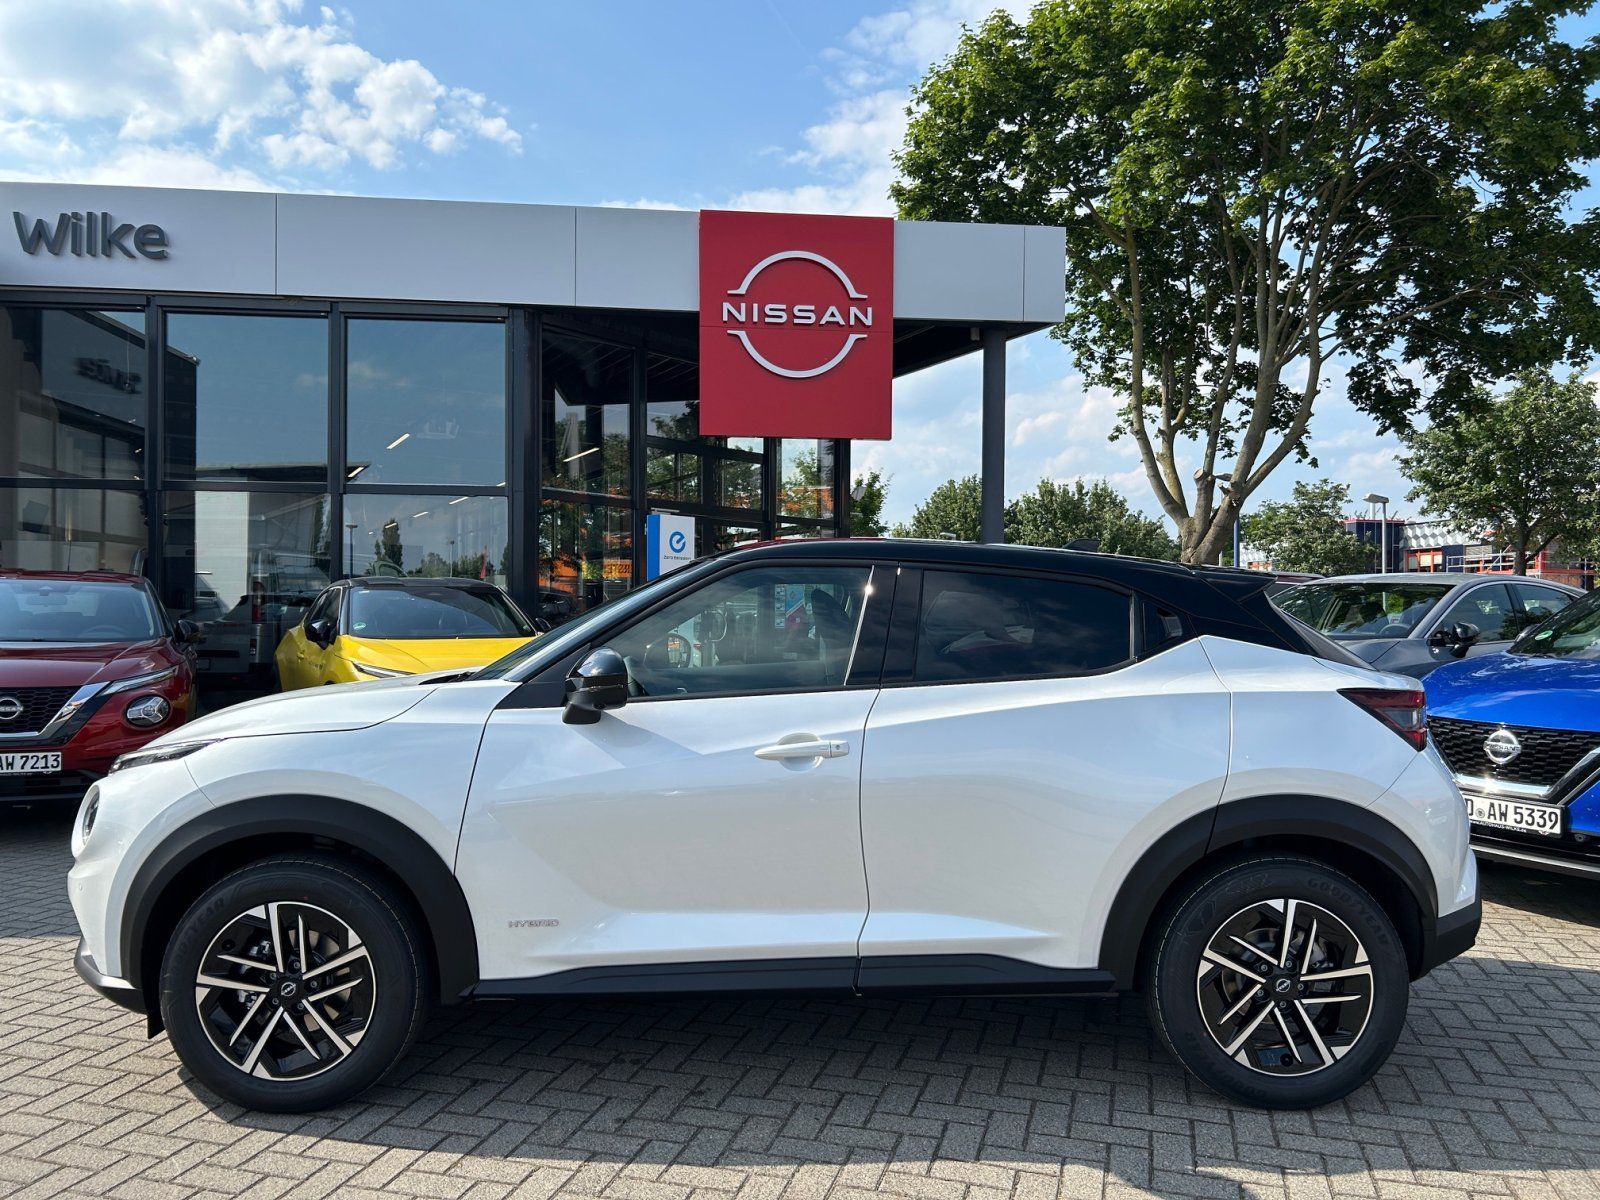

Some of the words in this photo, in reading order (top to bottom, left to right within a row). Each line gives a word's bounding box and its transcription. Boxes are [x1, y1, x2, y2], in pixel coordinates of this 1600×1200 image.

[12, 211, 170, 260] Wilke
[722, 302, 873, 327] NISSAN
[20, 754, 60, 770] 7213
[1487, 802, 1508, 822] AW
[1513, 806, 1559, 830] 5339
[508, 919, 561, 928] HYBRID
